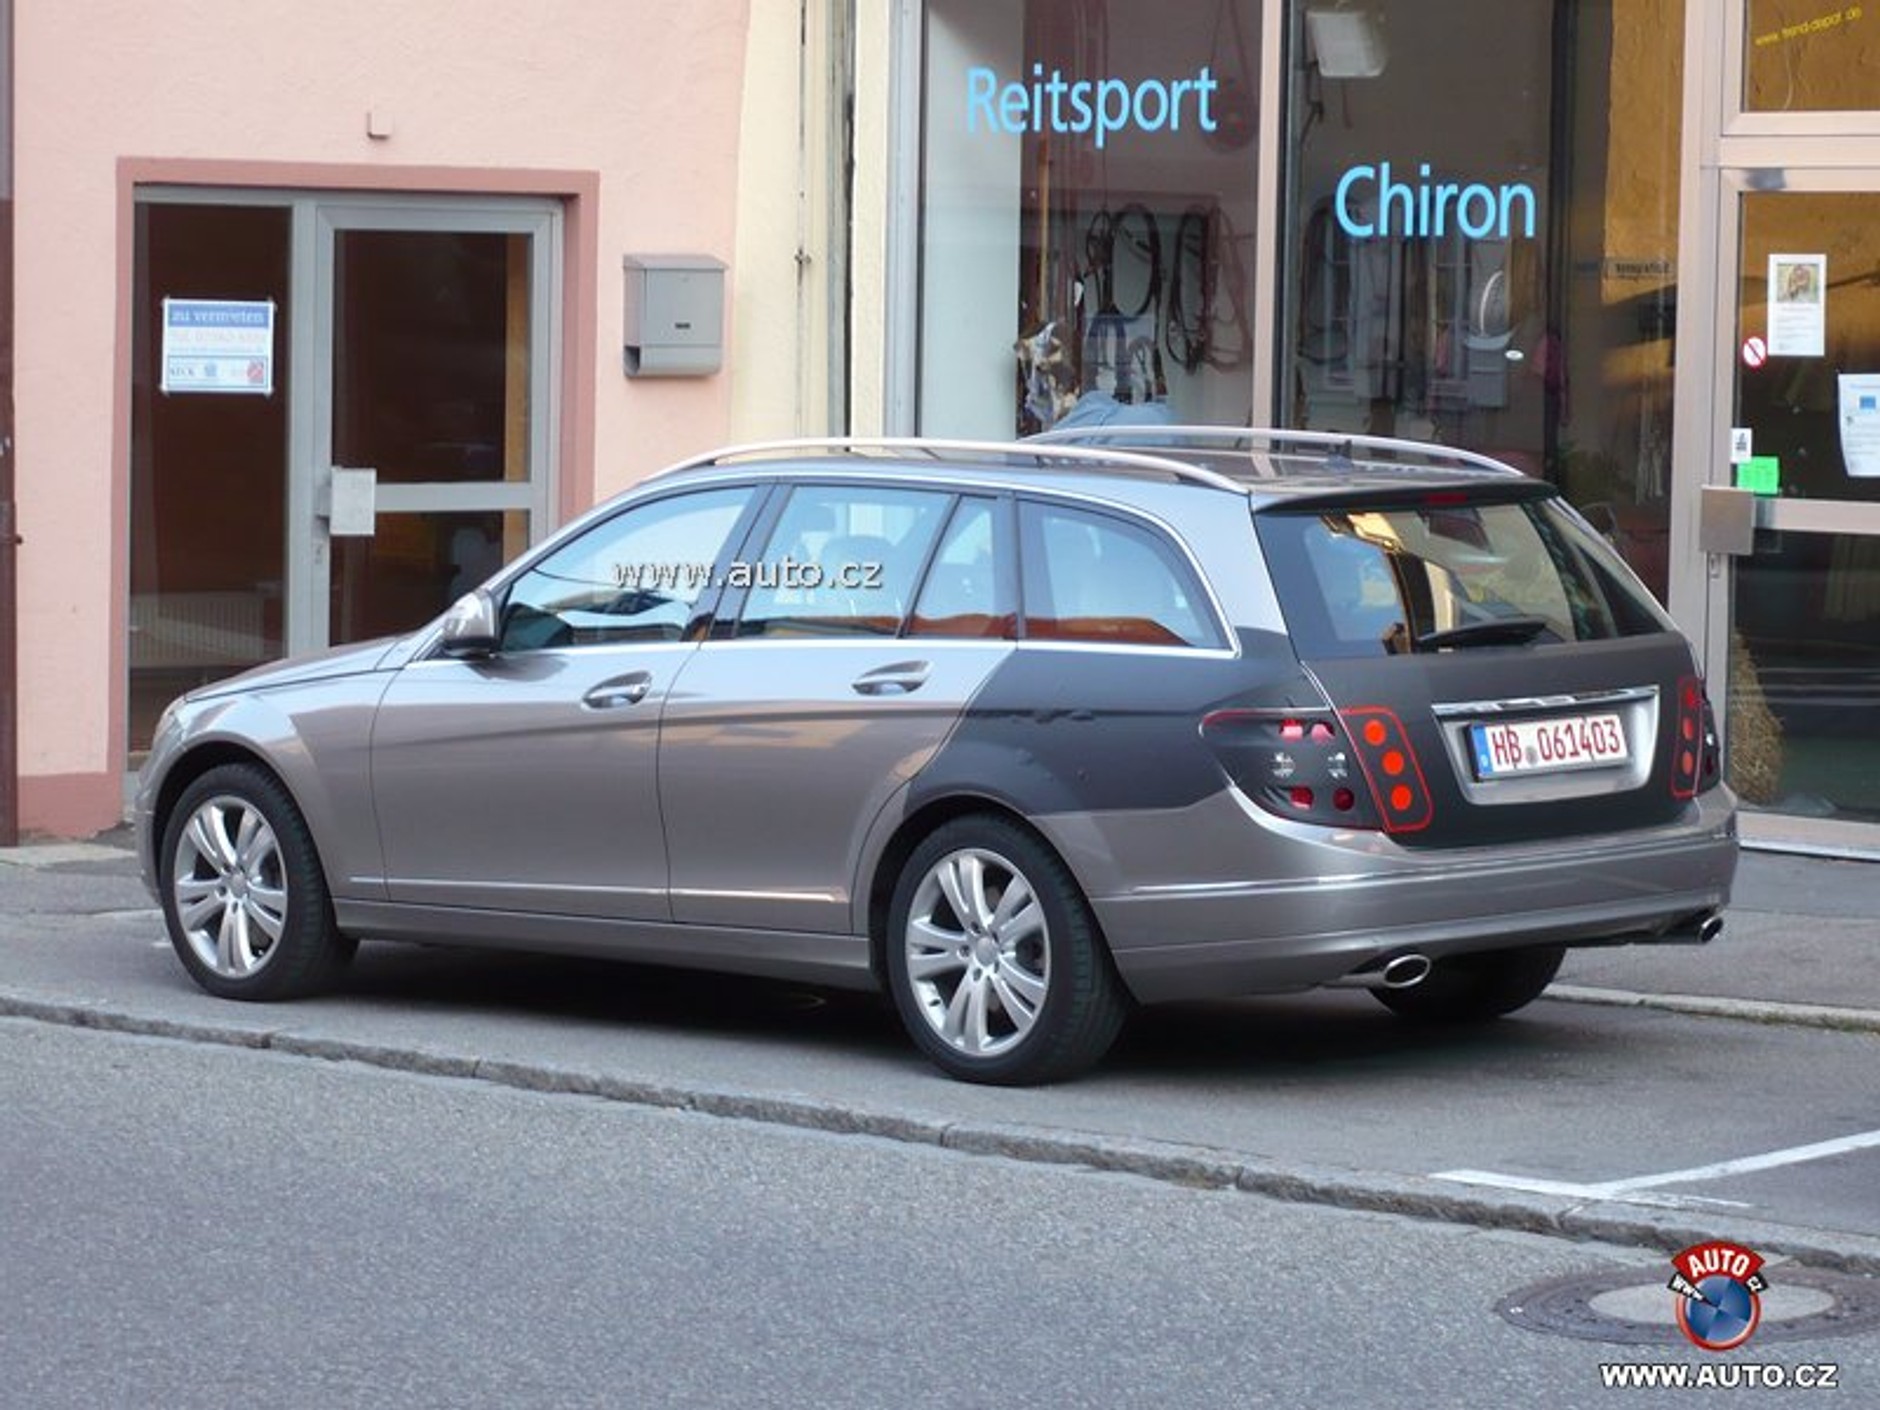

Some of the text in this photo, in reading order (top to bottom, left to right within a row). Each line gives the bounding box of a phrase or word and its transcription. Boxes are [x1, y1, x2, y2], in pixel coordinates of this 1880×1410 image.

[966, 63, 1218, 148] Reitsport
[1335, 162, 1535, 238] Chiron
[171, 309, 265, 324] zu vermieten
[1492, 719, 1621, 766] HB 061403
